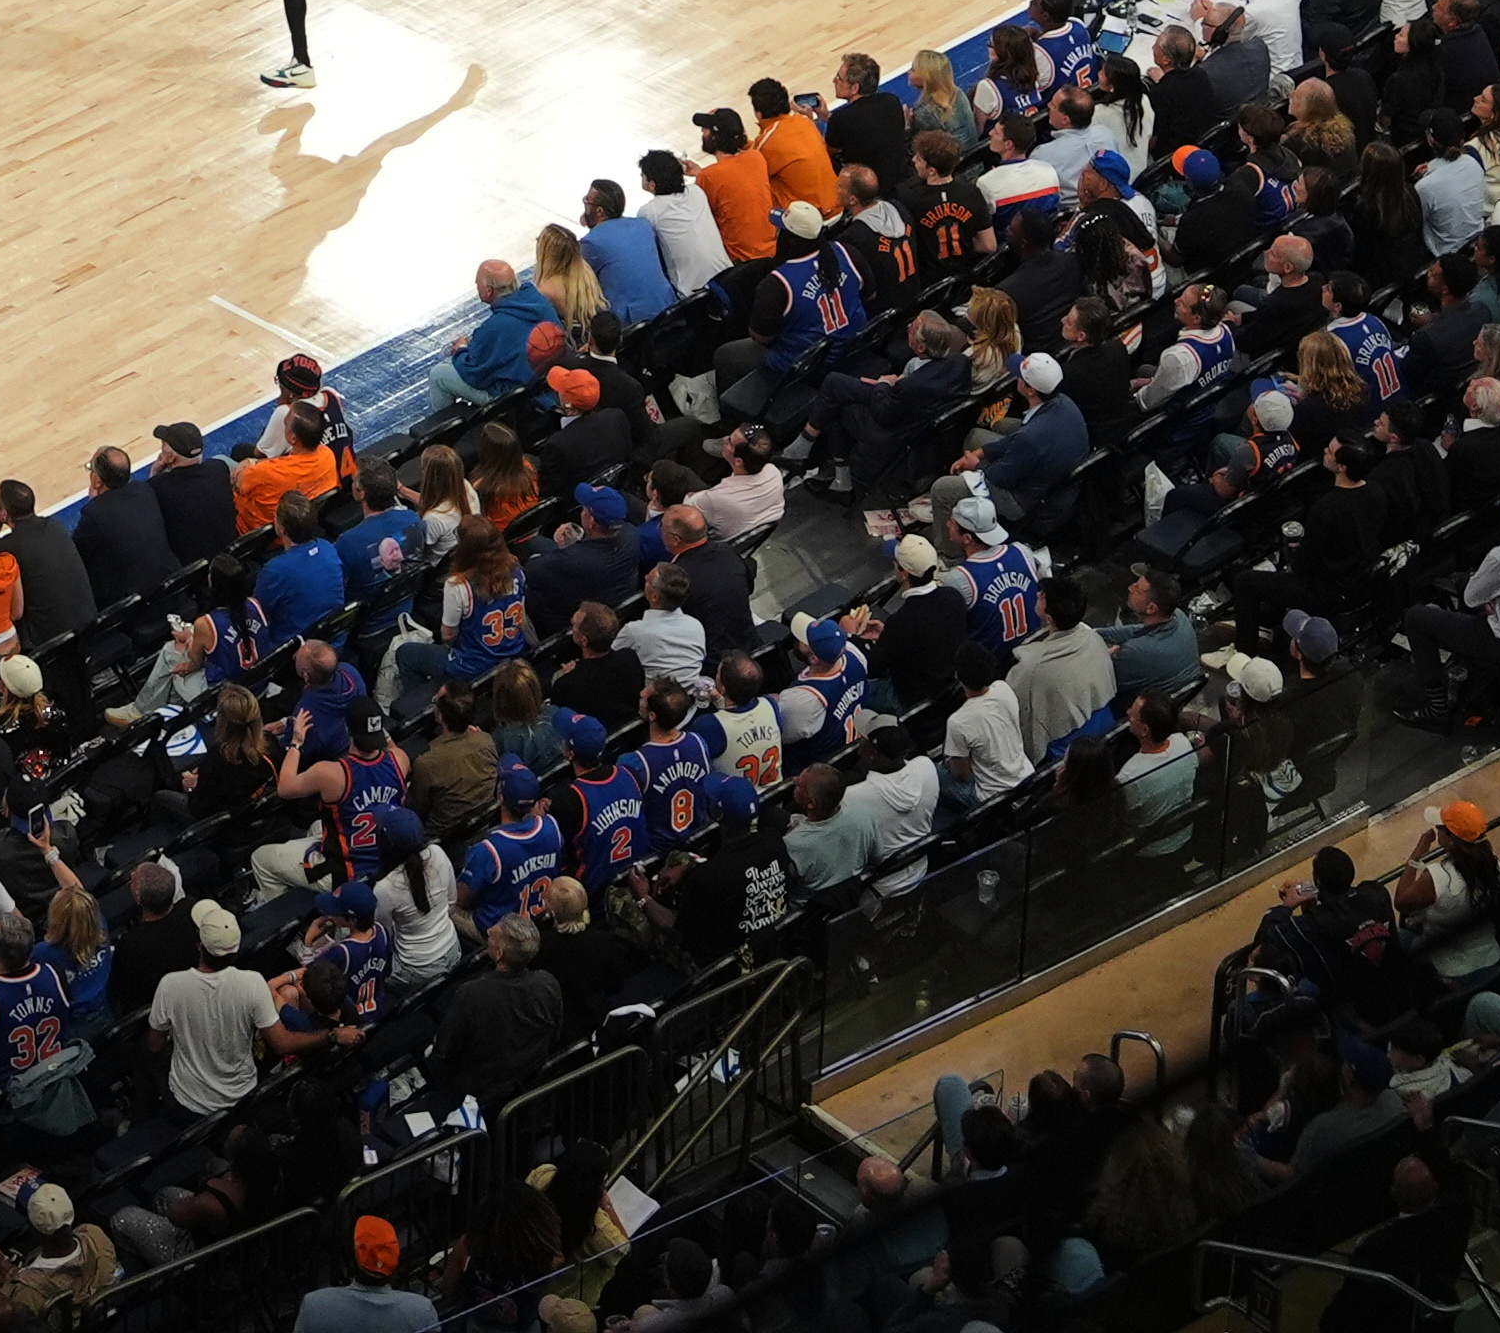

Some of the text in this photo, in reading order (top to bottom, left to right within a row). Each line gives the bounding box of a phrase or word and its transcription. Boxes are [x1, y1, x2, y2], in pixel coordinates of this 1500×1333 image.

[920, 201, 972, 228] BRUNSON
[936, 224, 962, 259] 11
[984, 572, 1031, 606] BRUNSON
[1001, 595, 1028, 640] 11
[736, 747, 780, 785] 32
[592, 799, 643, 837] JOHNSON
[671, 789, 694, 831] 8
[610, 827, 632, 862] 2
[510, 852, 558, 885] JACKSON
[8, 995, 54, 1023] TOWNS
[9, 1017, 62, 1069] 32
